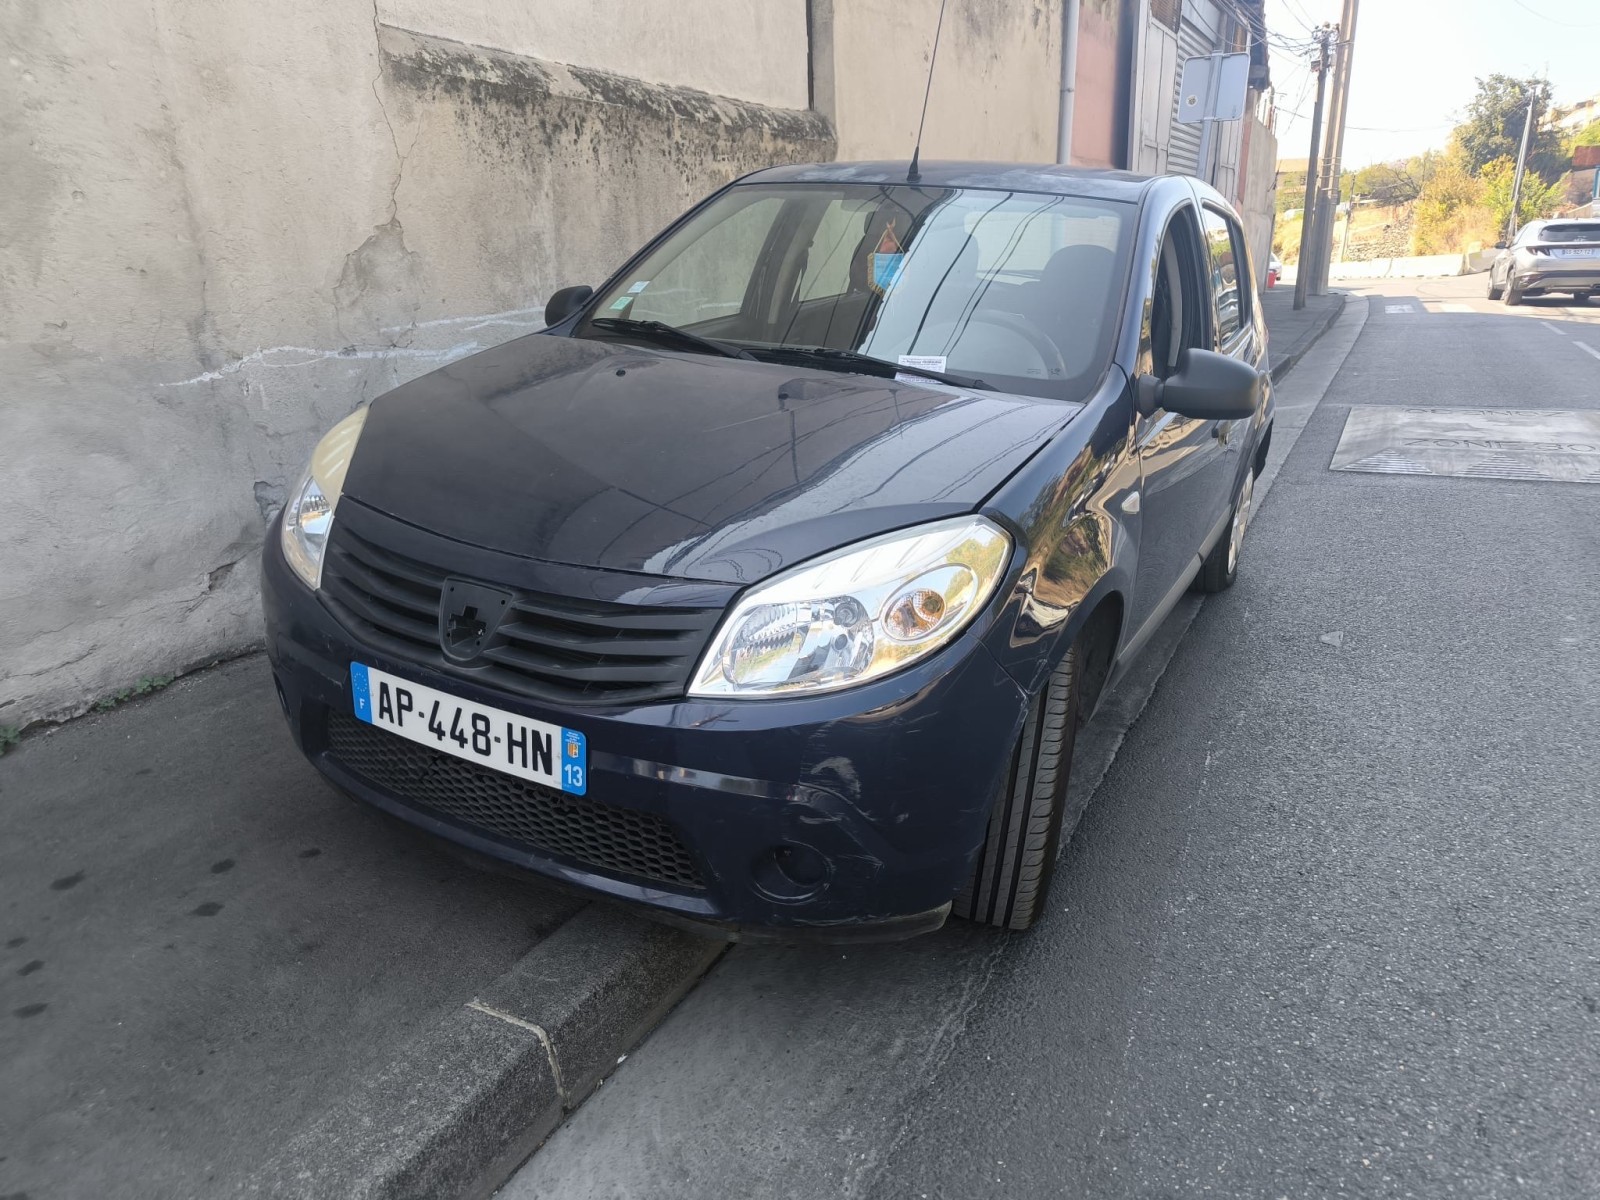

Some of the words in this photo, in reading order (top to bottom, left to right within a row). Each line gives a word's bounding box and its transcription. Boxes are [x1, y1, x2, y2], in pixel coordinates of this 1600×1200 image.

[1403, 438, 1526, 451] ZONE
[1534, 442, 1597, 452] 30
[359, 697, 365, 709] F
[379, 681, 553, 776] AP-448-HN
[564, 763, 583, 787] 13
